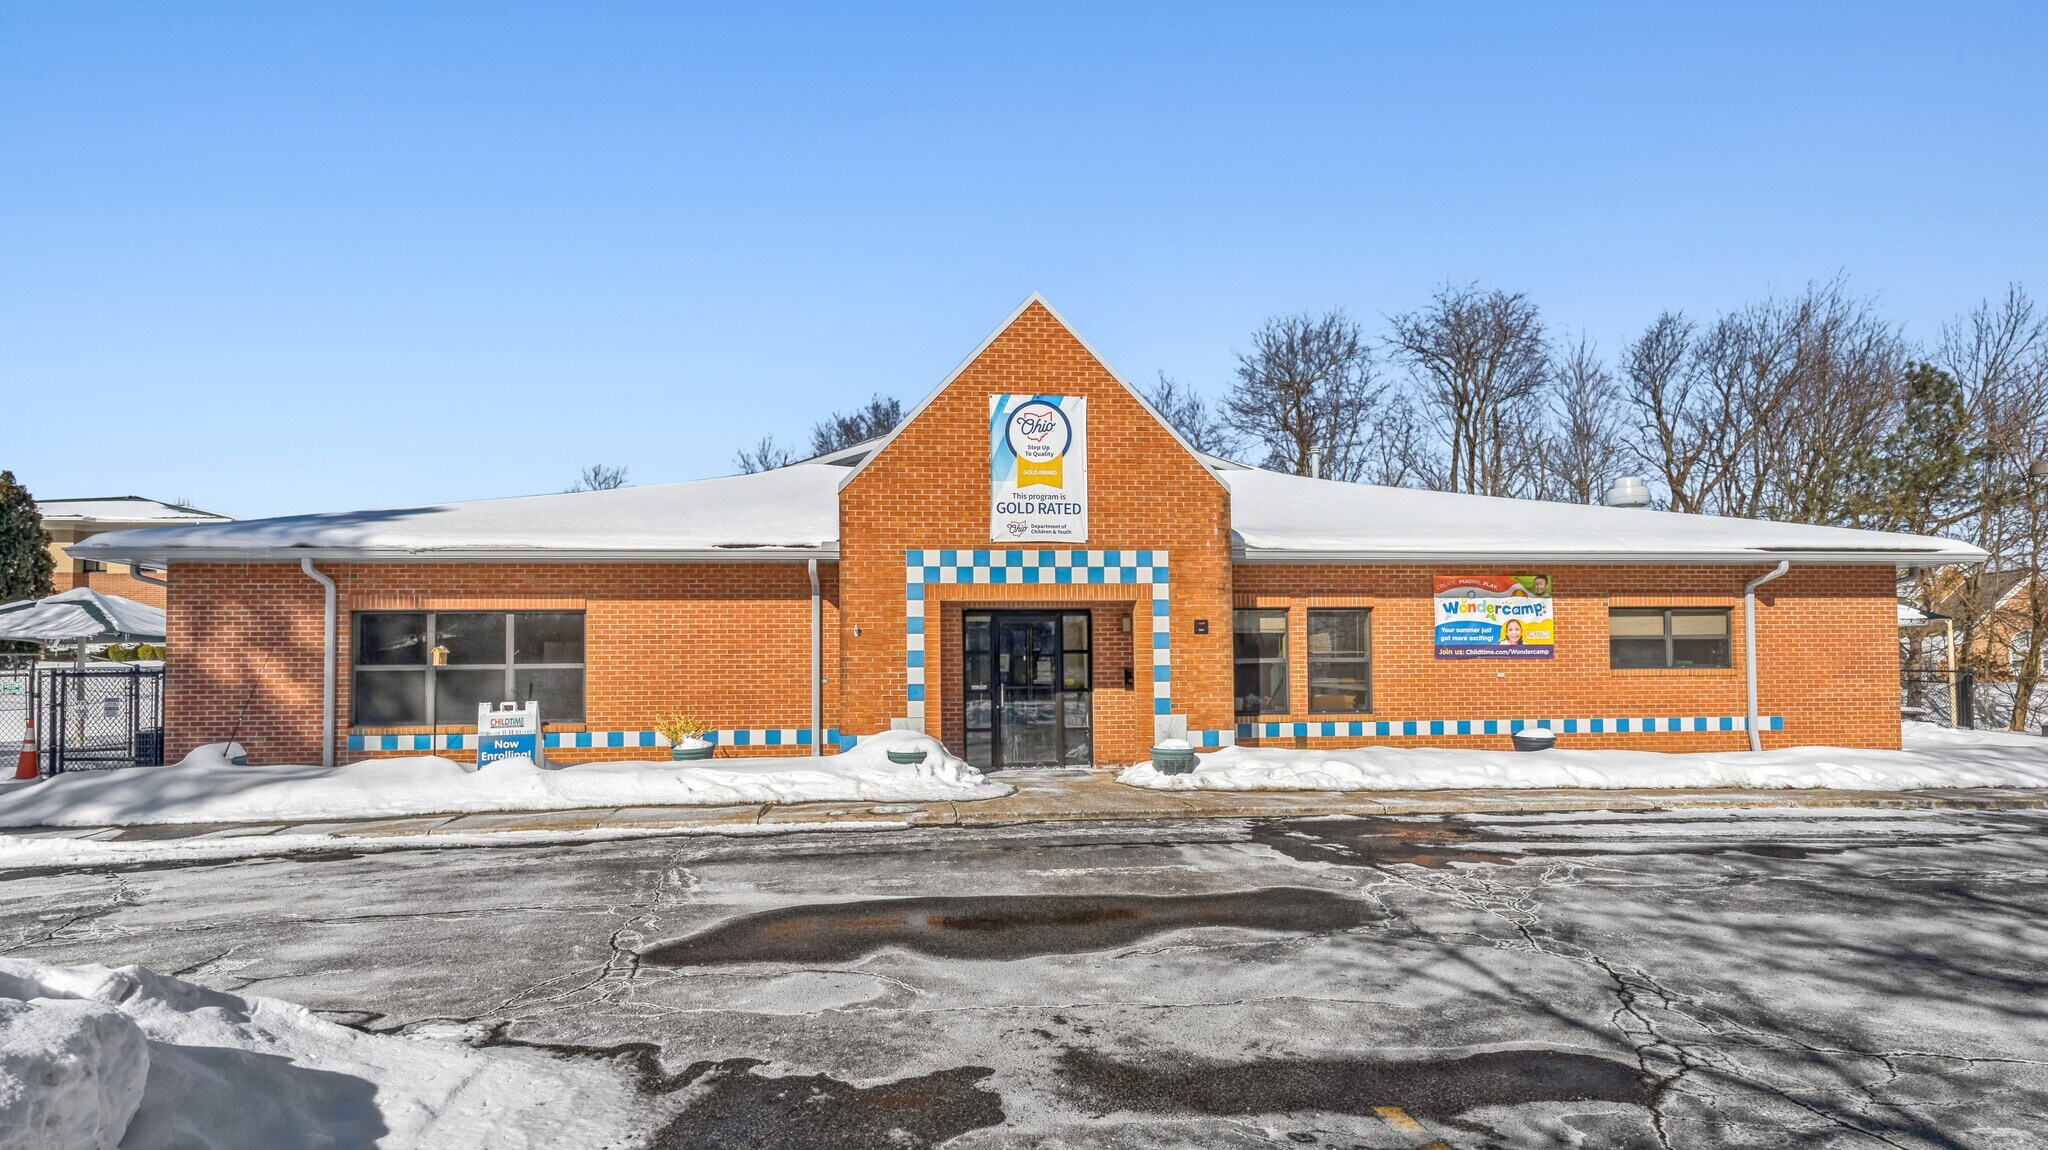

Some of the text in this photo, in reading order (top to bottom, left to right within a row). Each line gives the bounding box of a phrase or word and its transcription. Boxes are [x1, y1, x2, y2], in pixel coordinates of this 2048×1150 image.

[1017, 417, 1056, 435] Ohio
[996, 502, 1081, 515] GOLD RATED
[1007, 523, 1028, 533] Ohio
[1483, 581, 1498, 590] PLAY.
[1442, 600, 1542, 616] Wondercamp
[494, 740, 519, 749] Now
